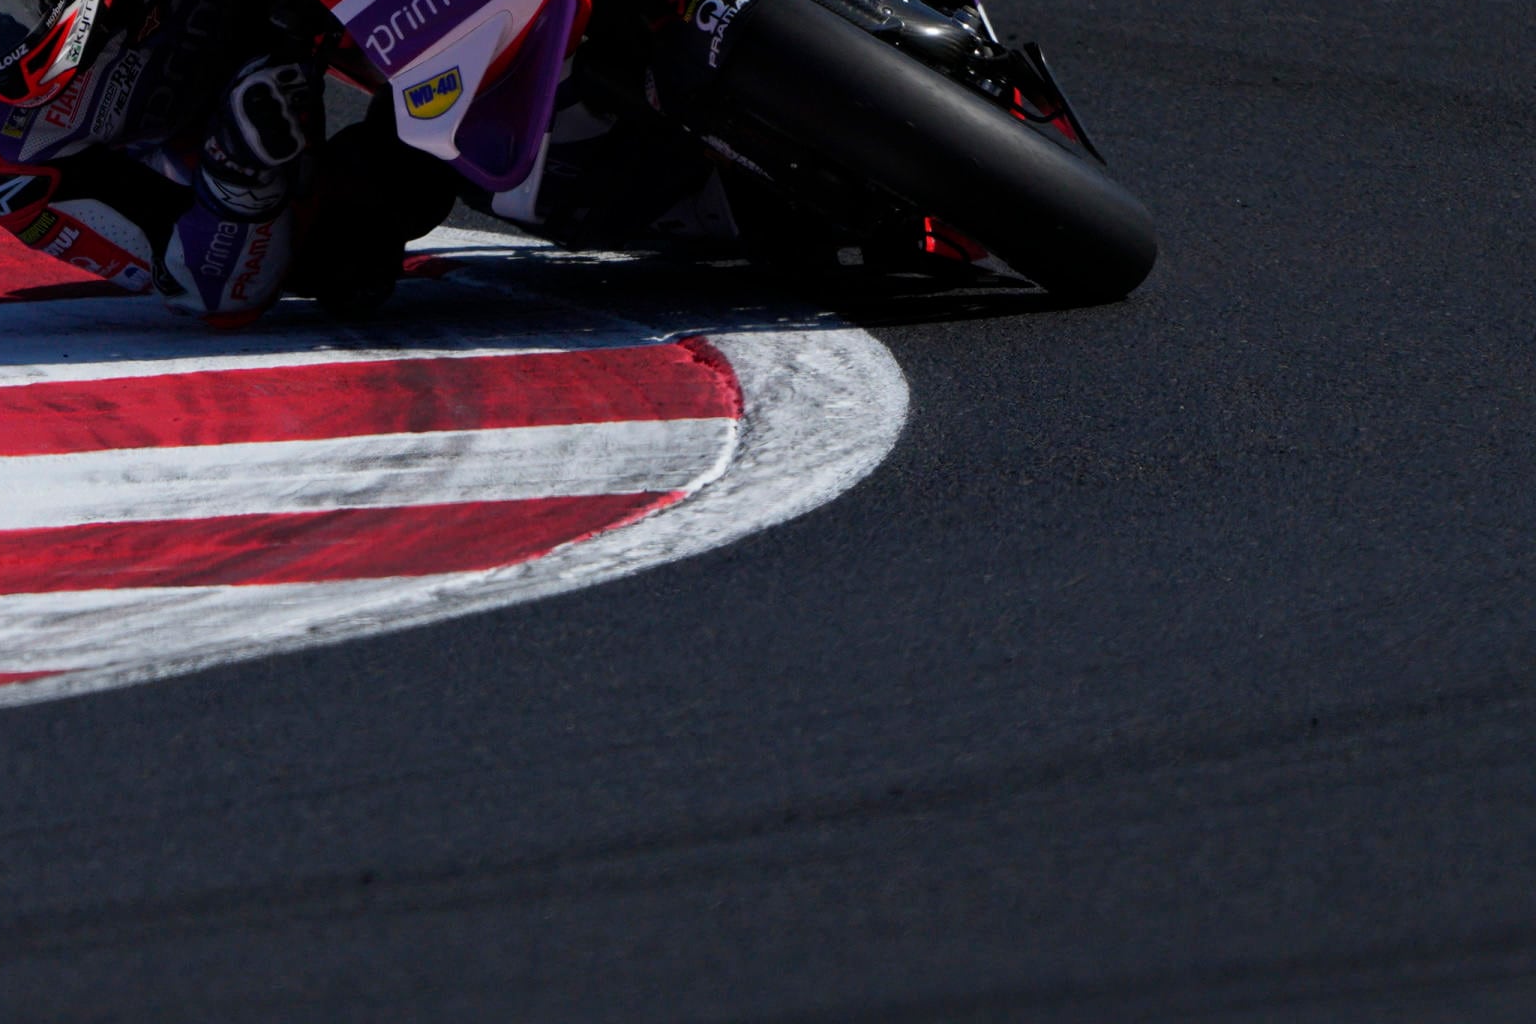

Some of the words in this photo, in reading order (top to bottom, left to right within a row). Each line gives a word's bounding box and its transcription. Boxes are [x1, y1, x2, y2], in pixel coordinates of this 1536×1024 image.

[409, 72, 457, 108] WD-40
[199, 220, 240, 276] prima
[230, 219, 274, 301] PRAMA
